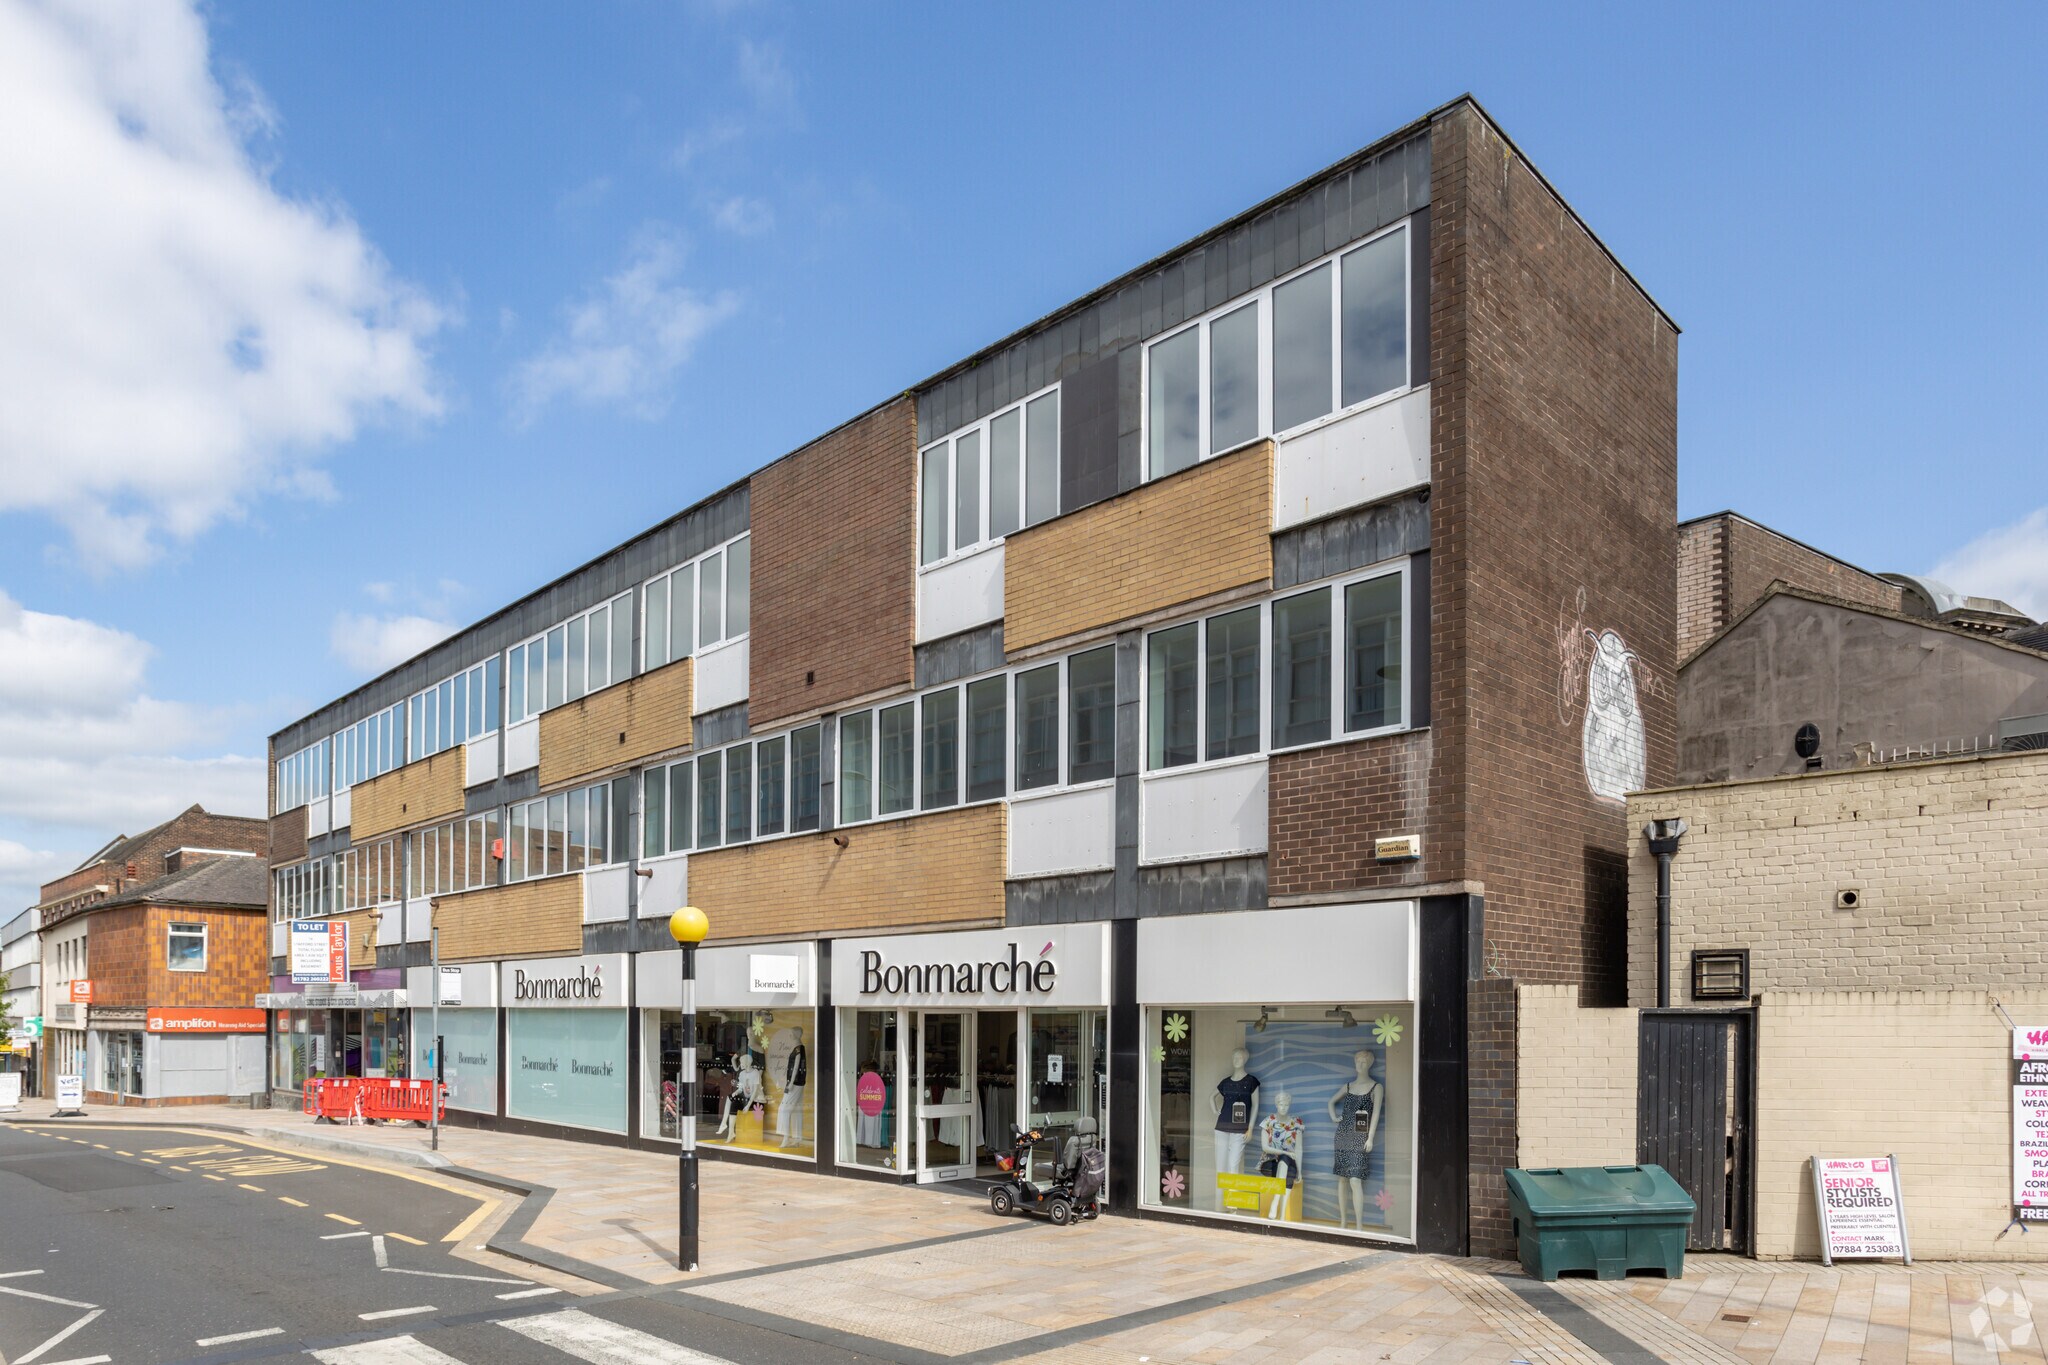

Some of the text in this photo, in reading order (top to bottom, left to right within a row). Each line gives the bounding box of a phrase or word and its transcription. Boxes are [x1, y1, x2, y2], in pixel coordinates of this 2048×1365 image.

[1377, 844, 1409, 854] Guardian
[297, 923, 324, 931] TO LET
[330, 923, 347, 954] Taylor
[331, 955, 344, 981] Louis
[858, 941, 1056, 994] Bonmarché
[514, 964, 602, 999] Bonmarché
[753, 978, 796, 989] Bonmarché
[165, 1018, 217, 1030] amplifon
[458, 1051, 489, 1066] Bonmarché
[521, 1055, 559, 1073] Bonmarché
[571, 1058, 614, 1077] Bonmarché
[2020, 1062, 2048, 1073] AFR
[2024, 1089, 2048, 1097] EXTE
[1824, 1177, 1875, 1188] SENIOR
[1826, 1187, 1882, 1198] STYLISTS
[2021, 1190, 2036, 1198] ALL
[1827, 1197, 1893, 1208] REQUIRED
[1832, 1245, 1901, 1253] 07884 253083
